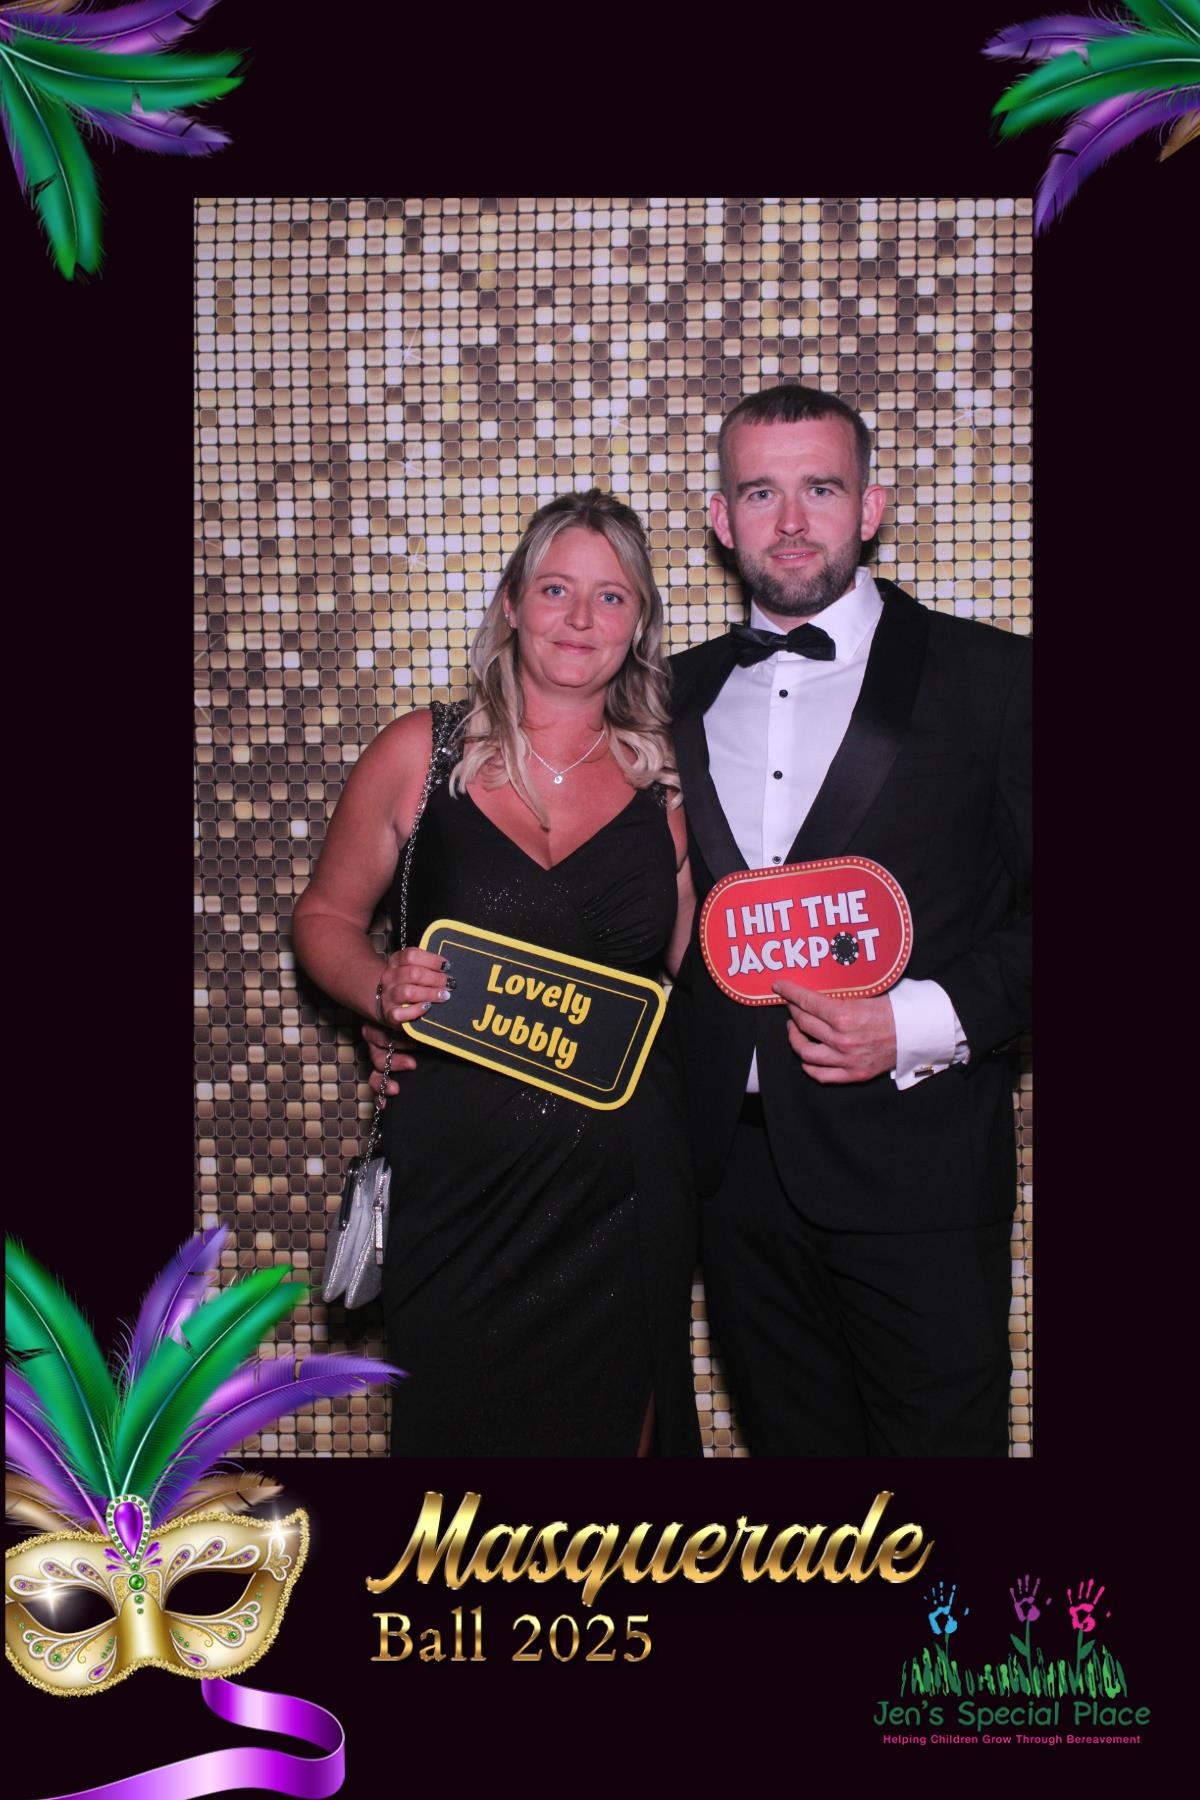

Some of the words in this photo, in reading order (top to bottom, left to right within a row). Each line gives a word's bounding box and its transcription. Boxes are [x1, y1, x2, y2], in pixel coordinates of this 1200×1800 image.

[725, 908, 737, 938] I
[741, 899, 794, 936] HIT
[801, 889, 869, 928] THE
[486, 963, 592, 1025] Lovely
[471, 1003, 578, 1069] Jubbly
